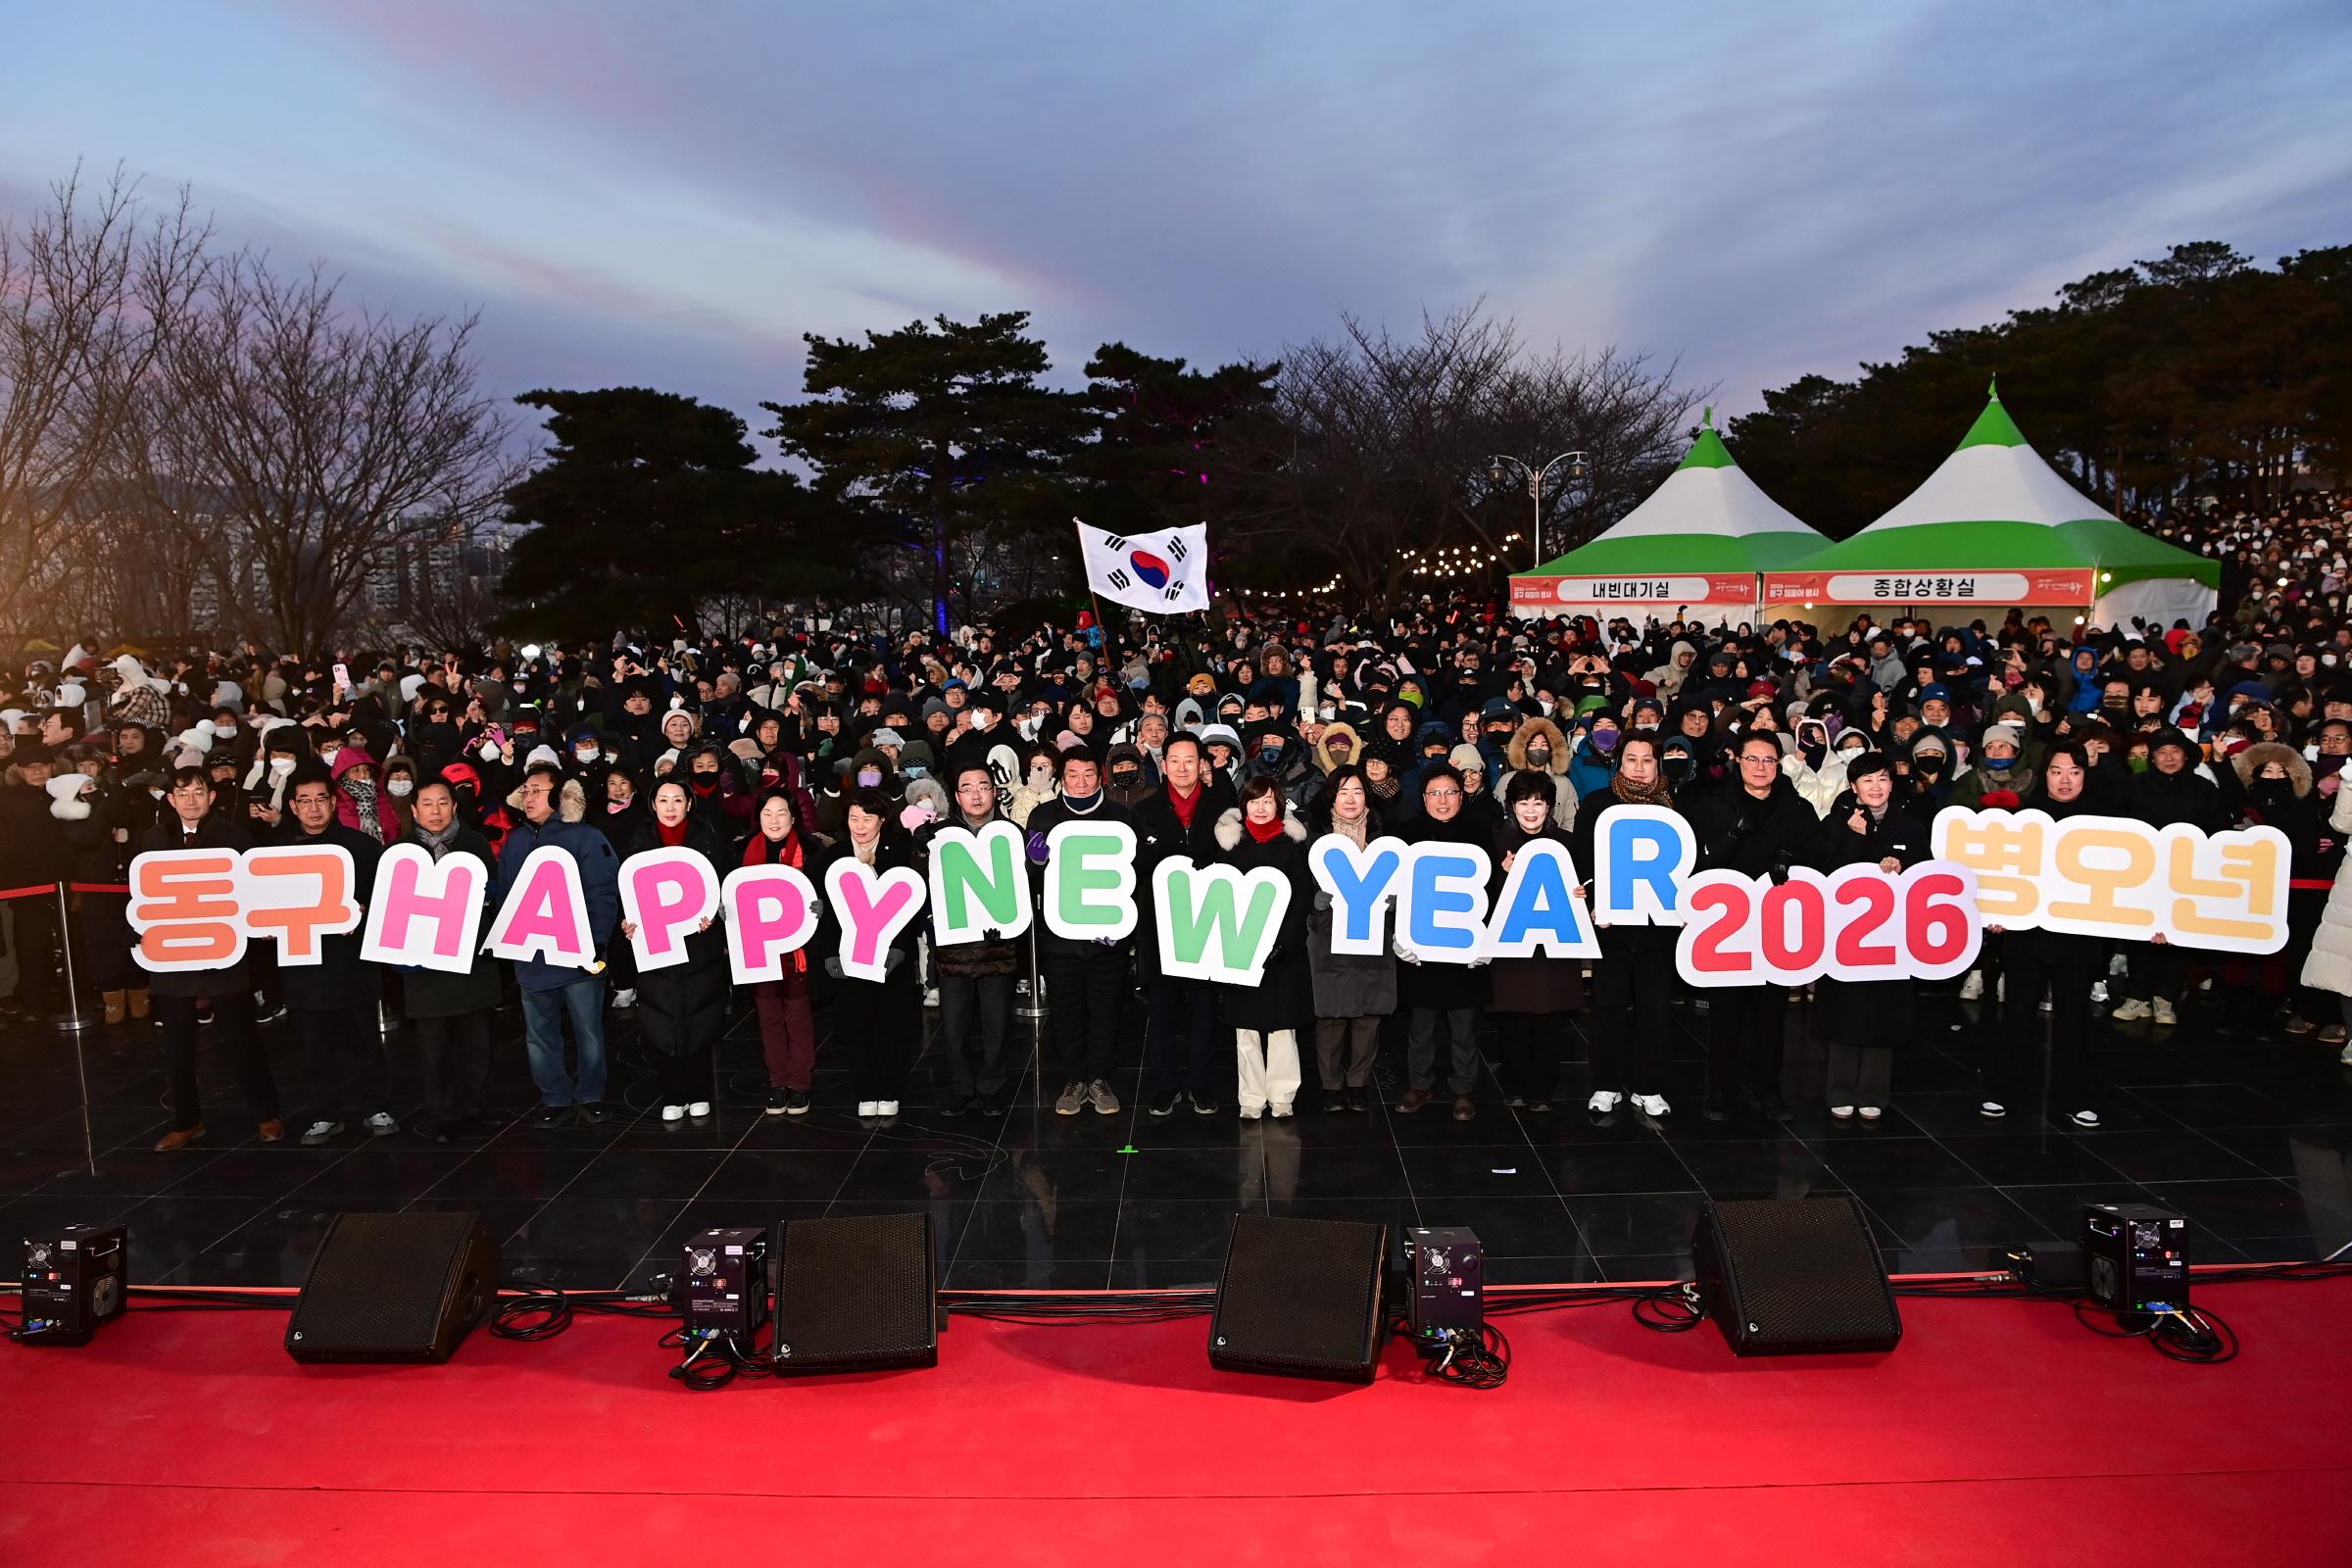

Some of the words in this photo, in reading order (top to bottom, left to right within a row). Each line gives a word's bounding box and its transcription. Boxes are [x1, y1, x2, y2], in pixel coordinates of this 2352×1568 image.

[1592, 581, 1669, 599] 내빈대기실
[1874, 578, 1975, 598] 종합상황실
[137, 855, 351, 962] 동구
[379, 858, 912, 968] HAPPY
[940, 835, 1277, 970] NEW
[1323, 818, 1682, 949] YEAR
[1690, 873, 1969, 972] 2026
[1945, 818, 2278, 941] 병오년
